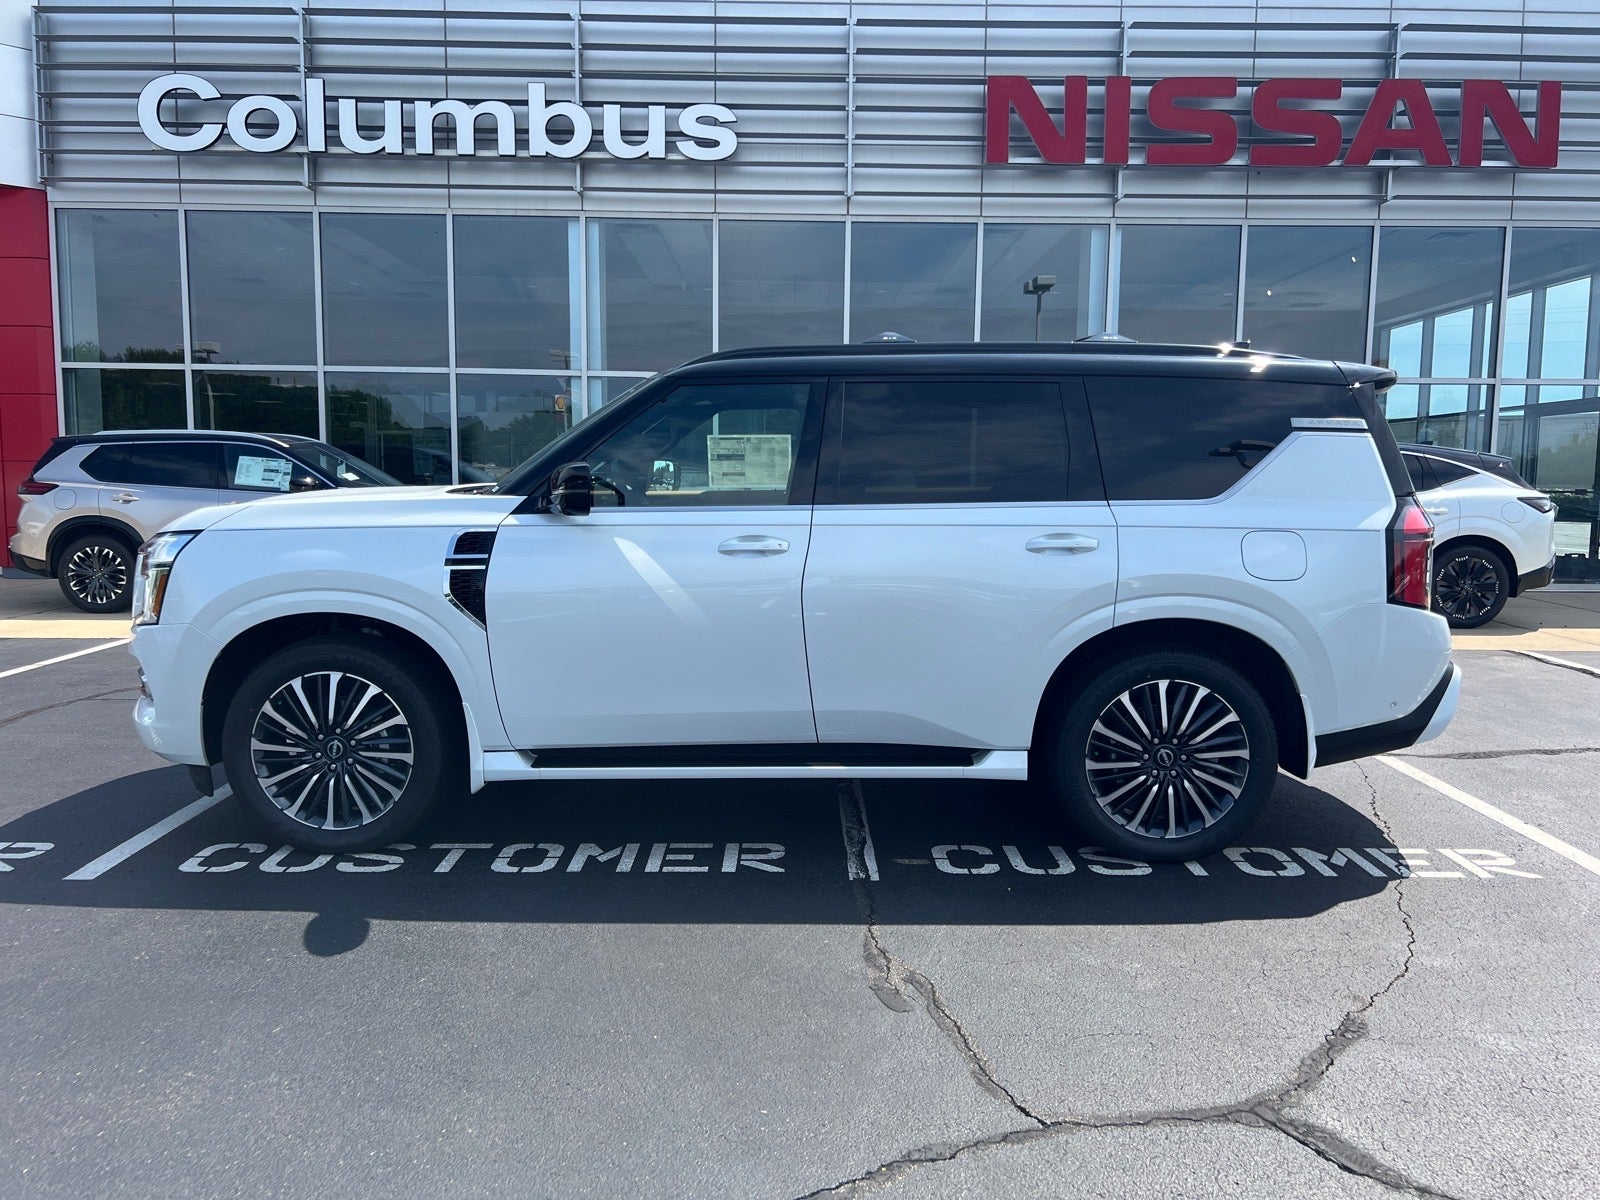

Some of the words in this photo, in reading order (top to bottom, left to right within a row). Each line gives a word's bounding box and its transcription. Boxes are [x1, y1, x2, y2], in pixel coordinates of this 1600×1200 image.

[137, 73, 738, 161] Columbus
[986, 75, 1562, 168] NISSAN
[178, 843, 786, 873] CUSTOMER
